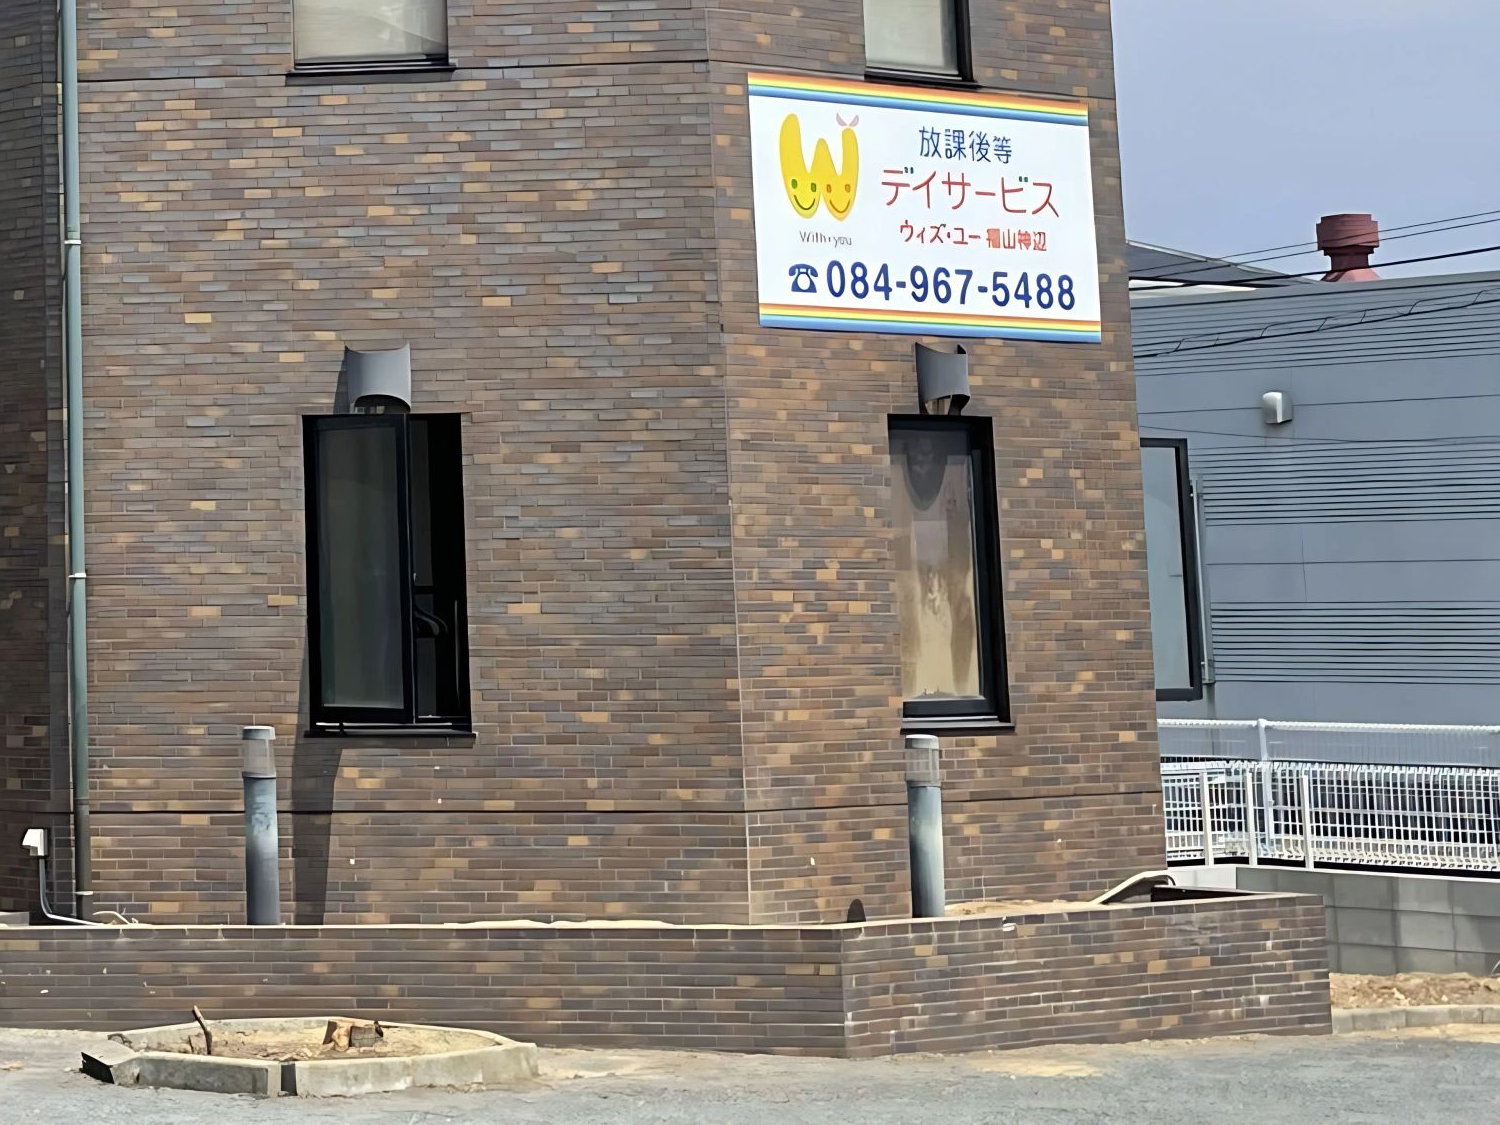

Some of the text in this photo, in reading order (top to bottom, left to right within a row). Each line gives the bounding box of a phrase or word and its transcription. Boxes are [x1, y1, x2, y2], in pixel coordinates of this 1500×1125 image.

[918, 125, 1013, 164] 放課後等
[881, 166, 1060, 218] デイサービス
[826, 260, 1076, 311] 084-967-5488
